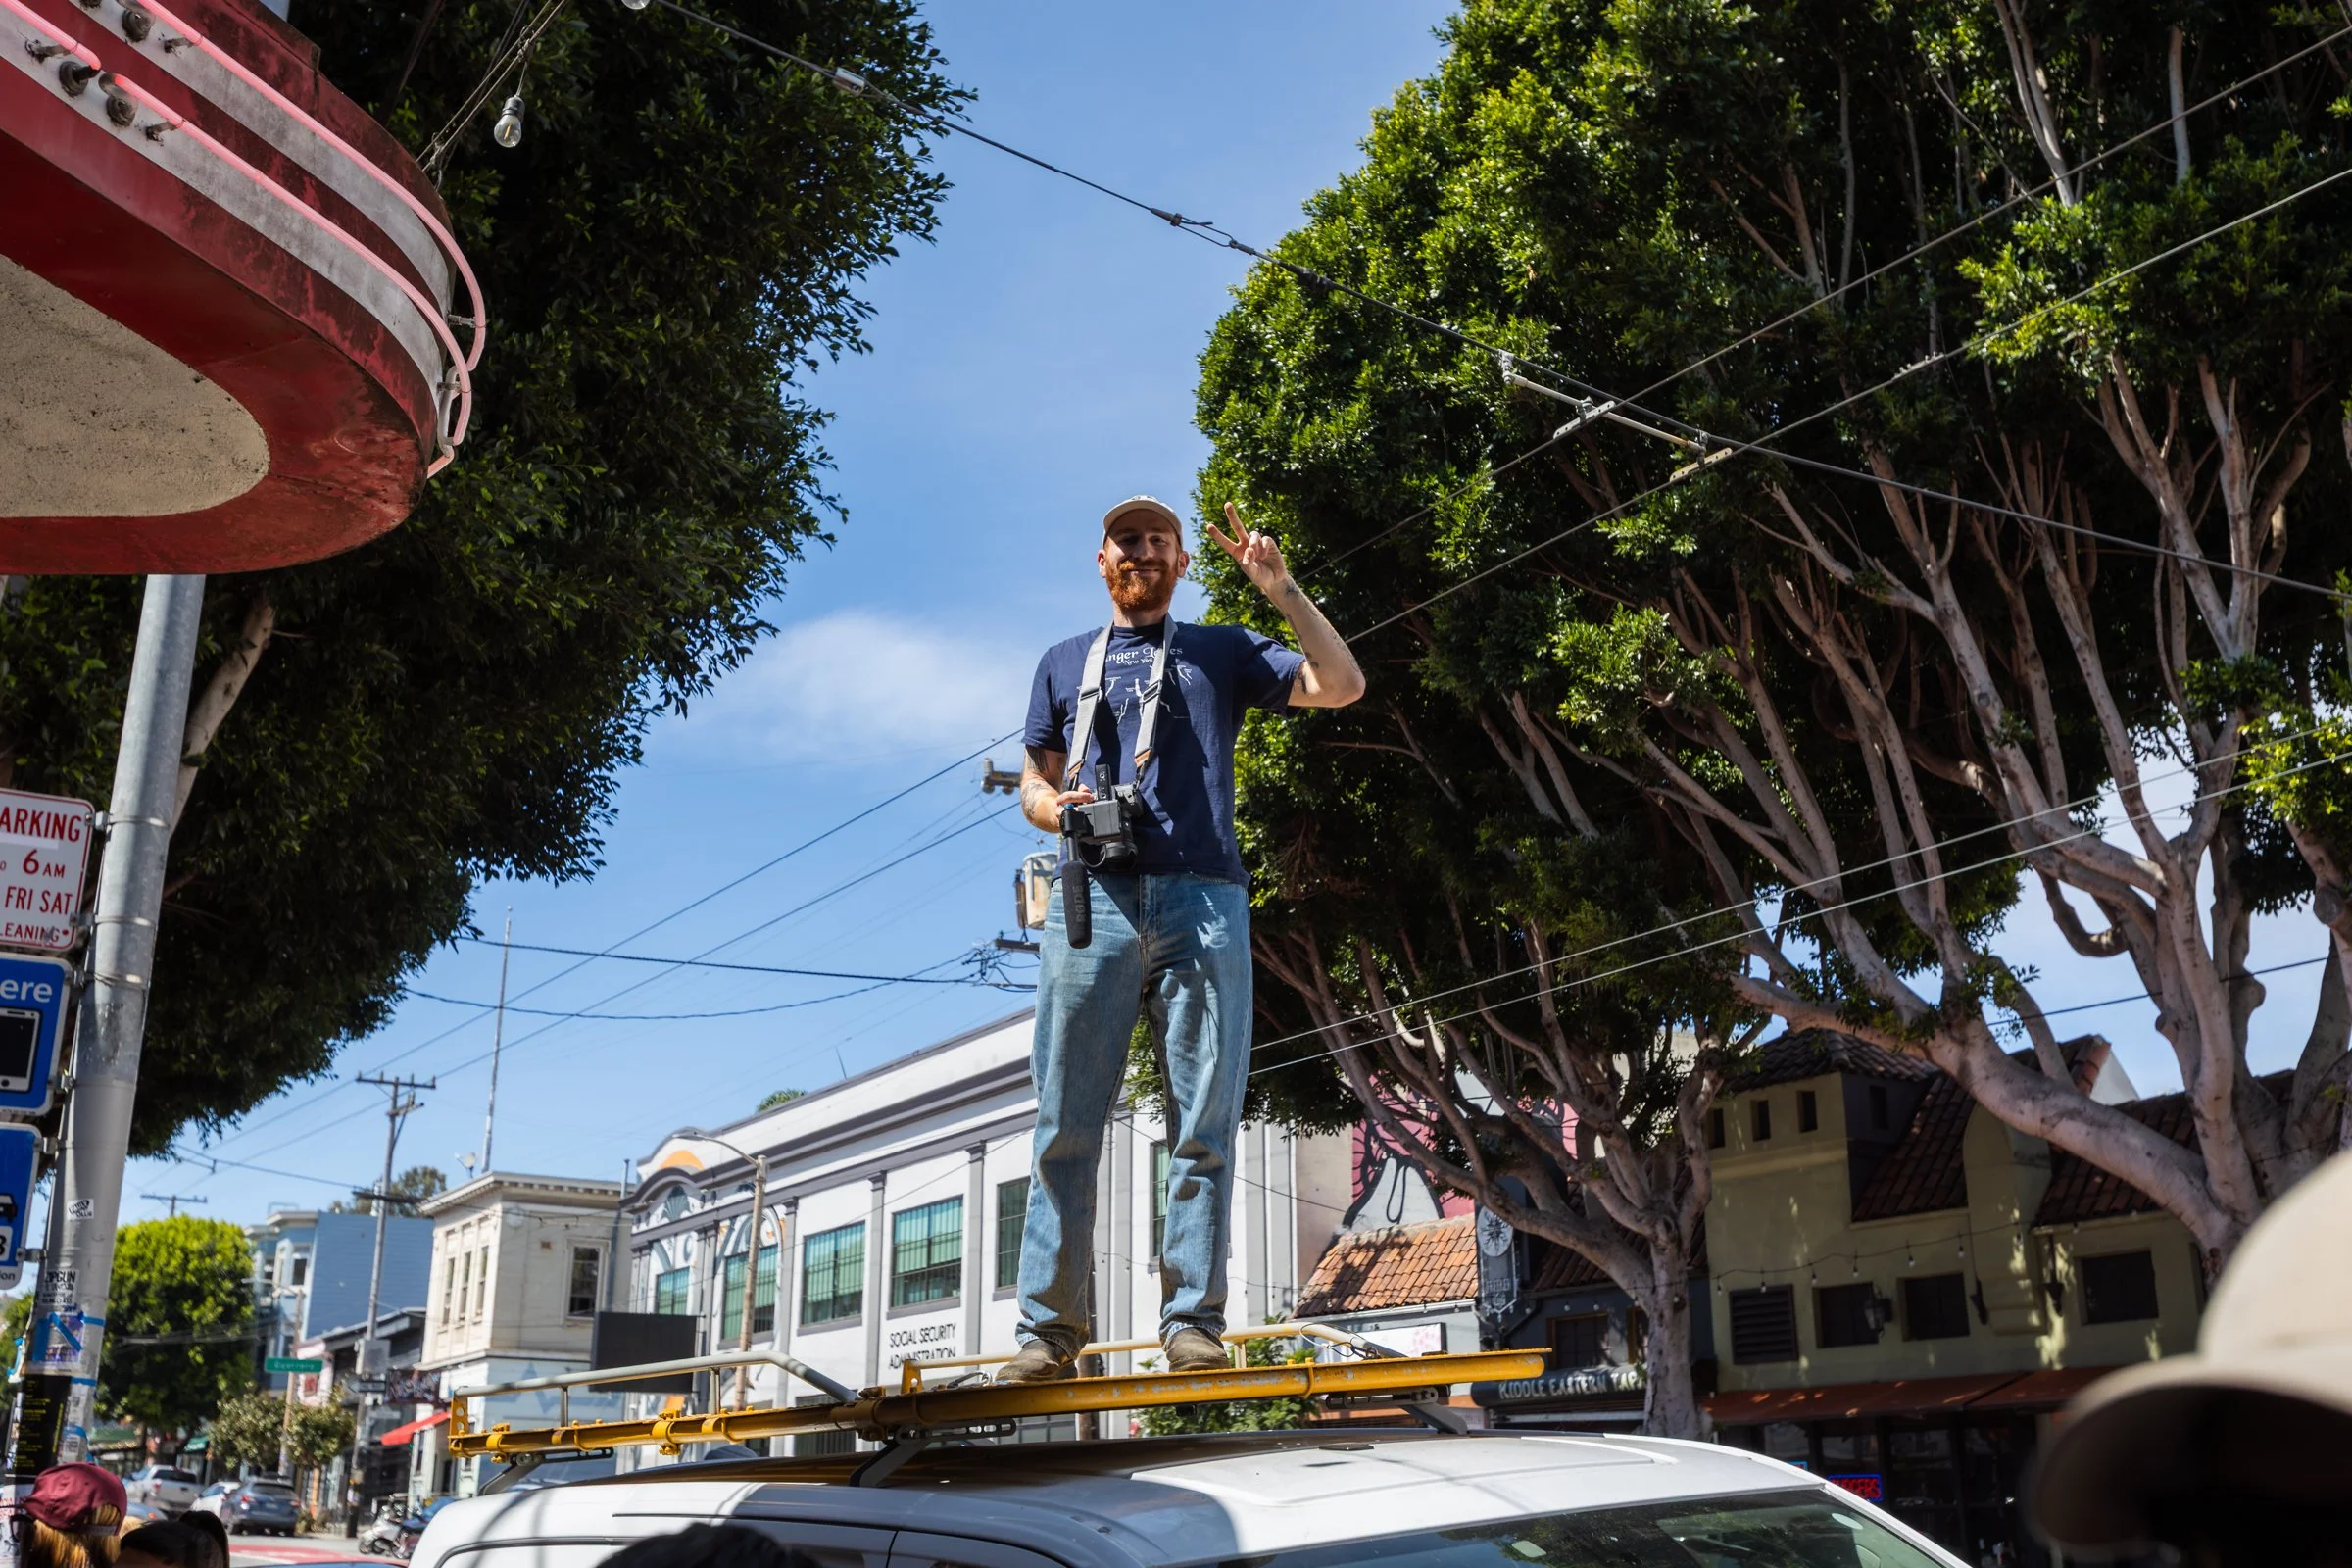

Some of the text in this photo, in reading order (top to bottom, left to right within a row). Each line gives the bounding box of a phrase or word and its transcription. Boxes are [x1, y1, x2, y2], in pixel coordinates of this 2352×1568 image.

[1143, 647, 1183, 660] Les
[0, 807, 81, 842] ARKING
[5, 886, 73, 915] FRI SAT
[0, 979, 53, 1004] ere
[890, 1323, 956, 1348] SOCIAL SECURITY
[1549, 1374, 1607, 1396] EASTERN
